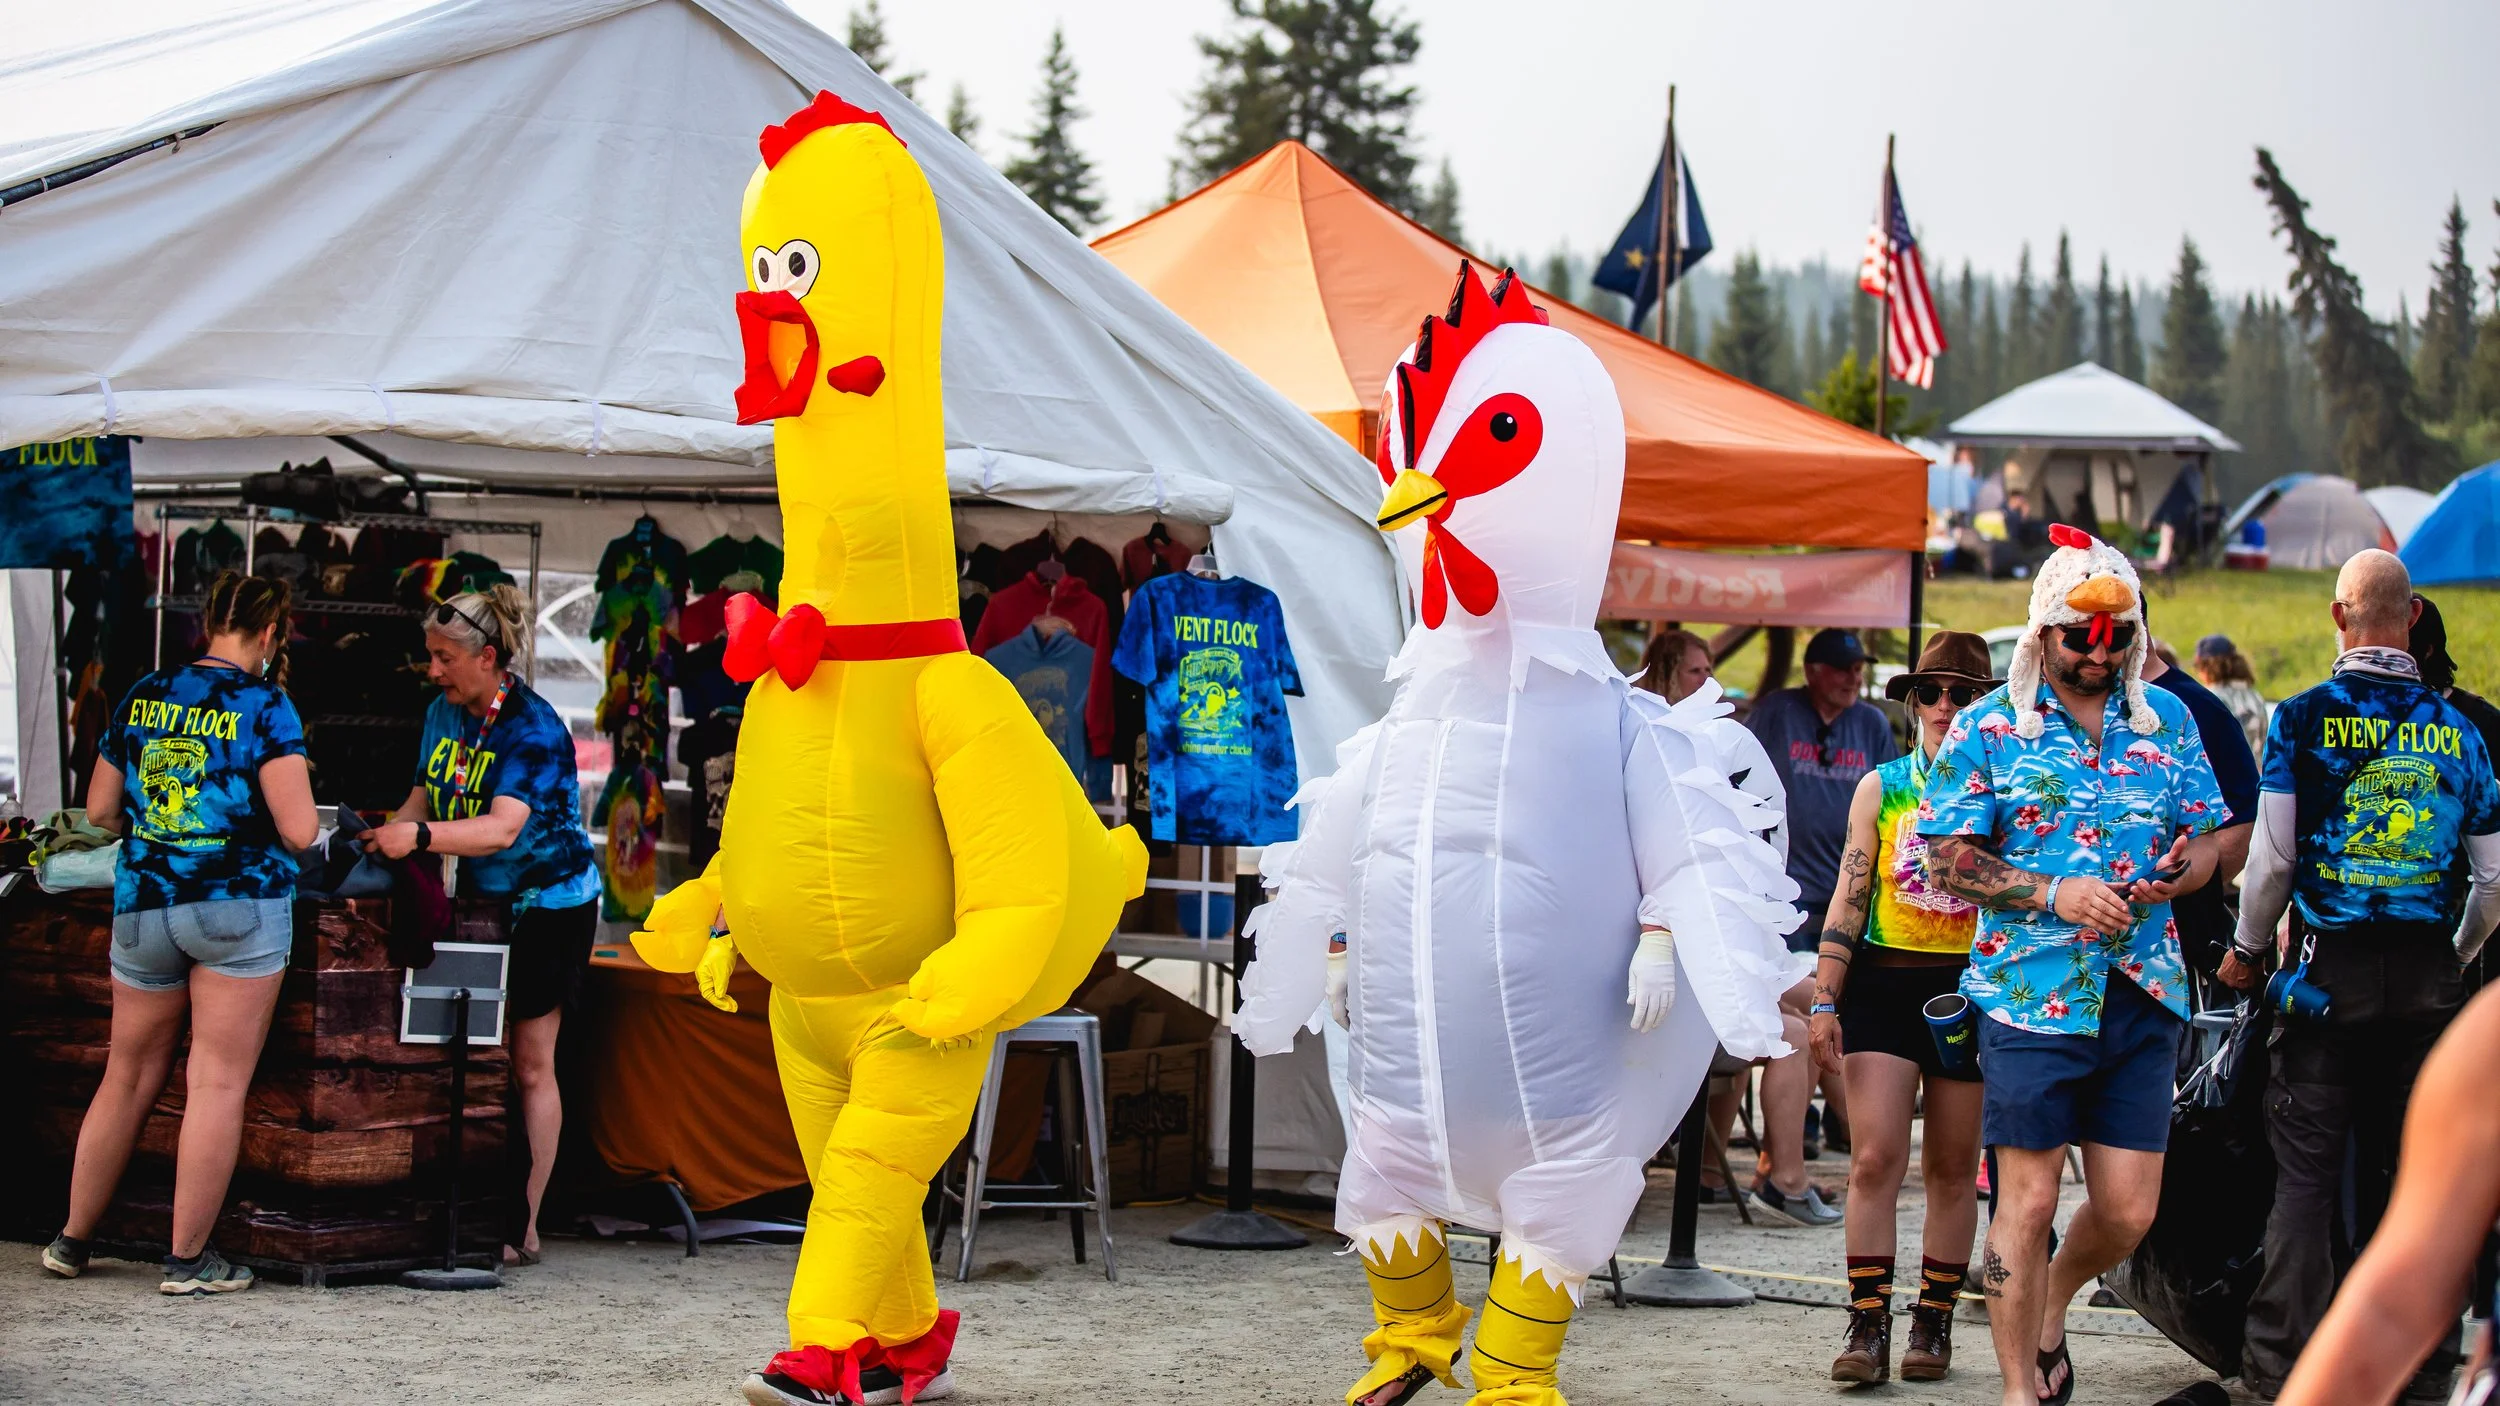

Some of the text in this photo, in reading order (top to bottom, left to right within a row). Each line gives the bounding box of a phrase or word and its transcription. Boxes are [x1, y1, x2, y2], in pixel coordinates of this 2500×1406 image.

[19, 437, 98, 466] FLOCK
[1174, 616, 1259, 649] VENT FLOCK
[128, 699, 243, 740] EVENT FLOCK
[2323, 717, 2463, 760] EVENT FLOCK
[427, 737, 496, 794] EVNT
[1790, 739, 1867, 769] GONAGA
[1907, 845, 1927, 858] 202
[2348, 844, 2378, 857] MUSIC
[2348, 869, 2375, 886] shine
[1899, 892, 1926, 908] MUSIC
